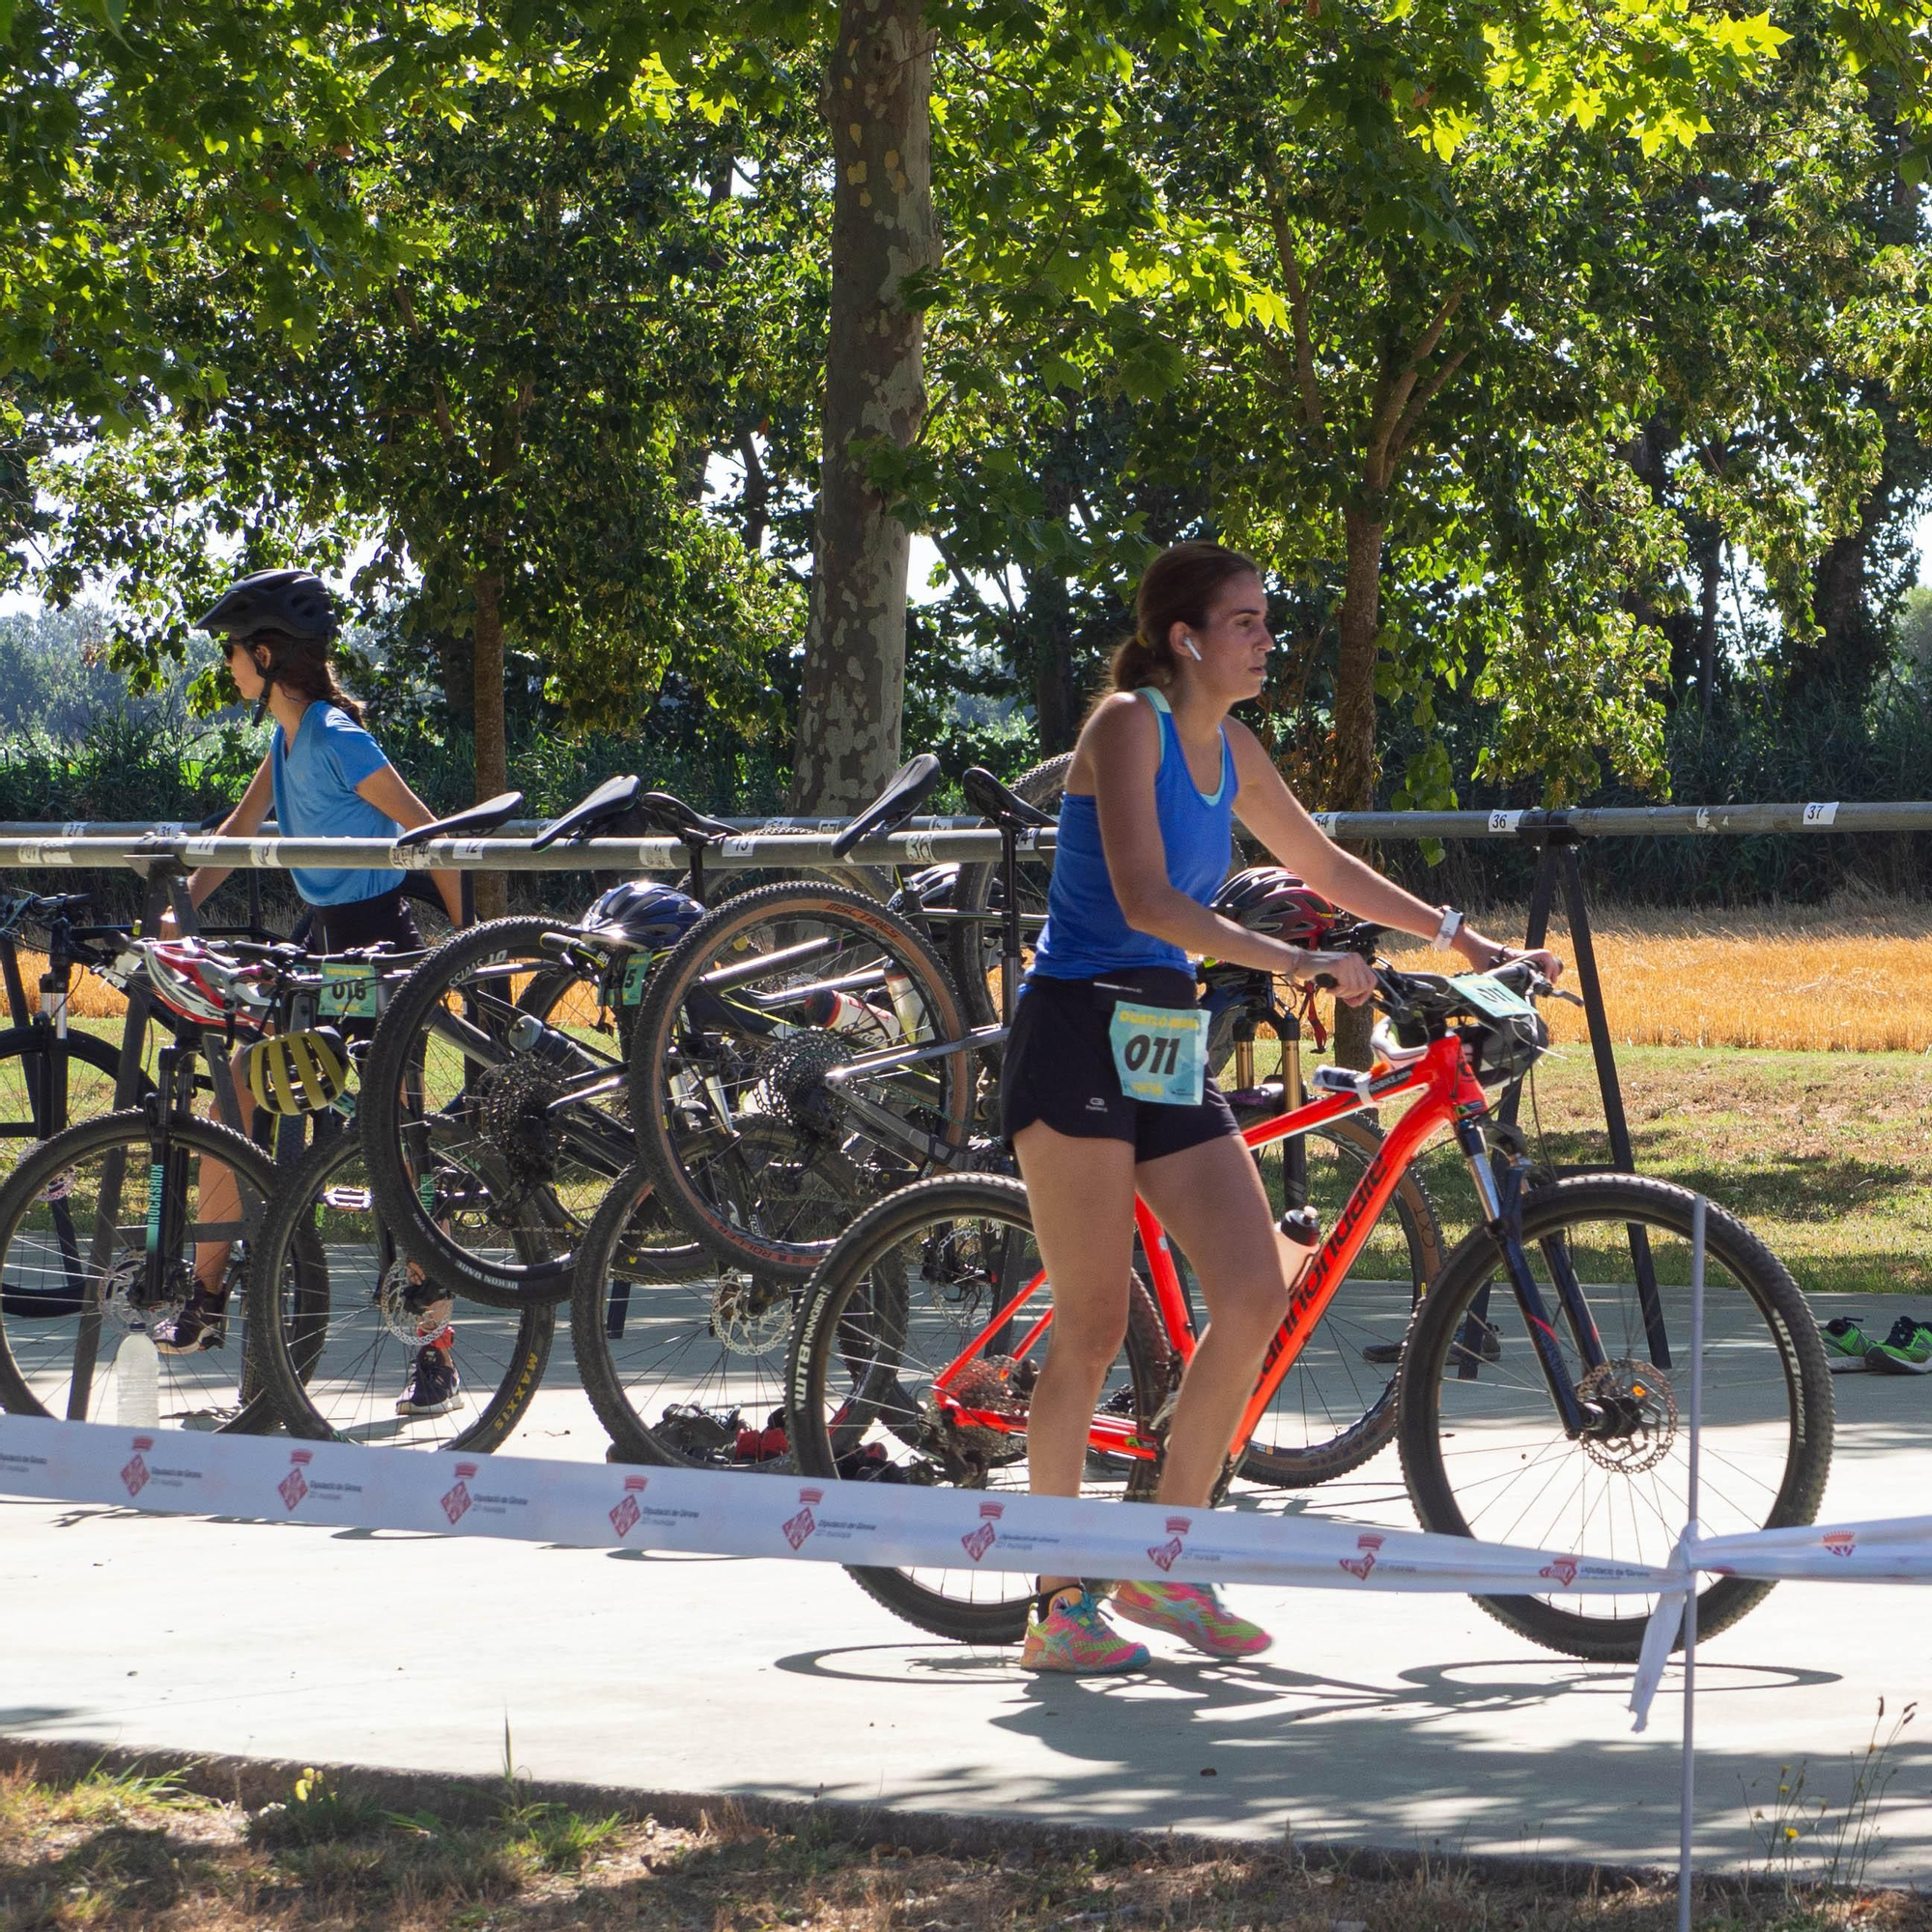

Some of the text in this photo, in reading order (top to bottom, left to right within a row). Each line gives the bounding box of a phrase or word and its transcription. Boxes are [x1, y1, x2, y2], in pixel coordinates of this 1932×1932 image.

[1492, 813, 1507, 829] 36
[1807, 805, 1824, 820] 37
[597, 951, 611, 965] BH
[1124, 1034, 1180, 1075] 011
[148, 1164, 164, 1225] ROCKSHOX
[802, 1293, 828, 1344] RANGER
[494, 1351, 538, 1430] MAXXIS
